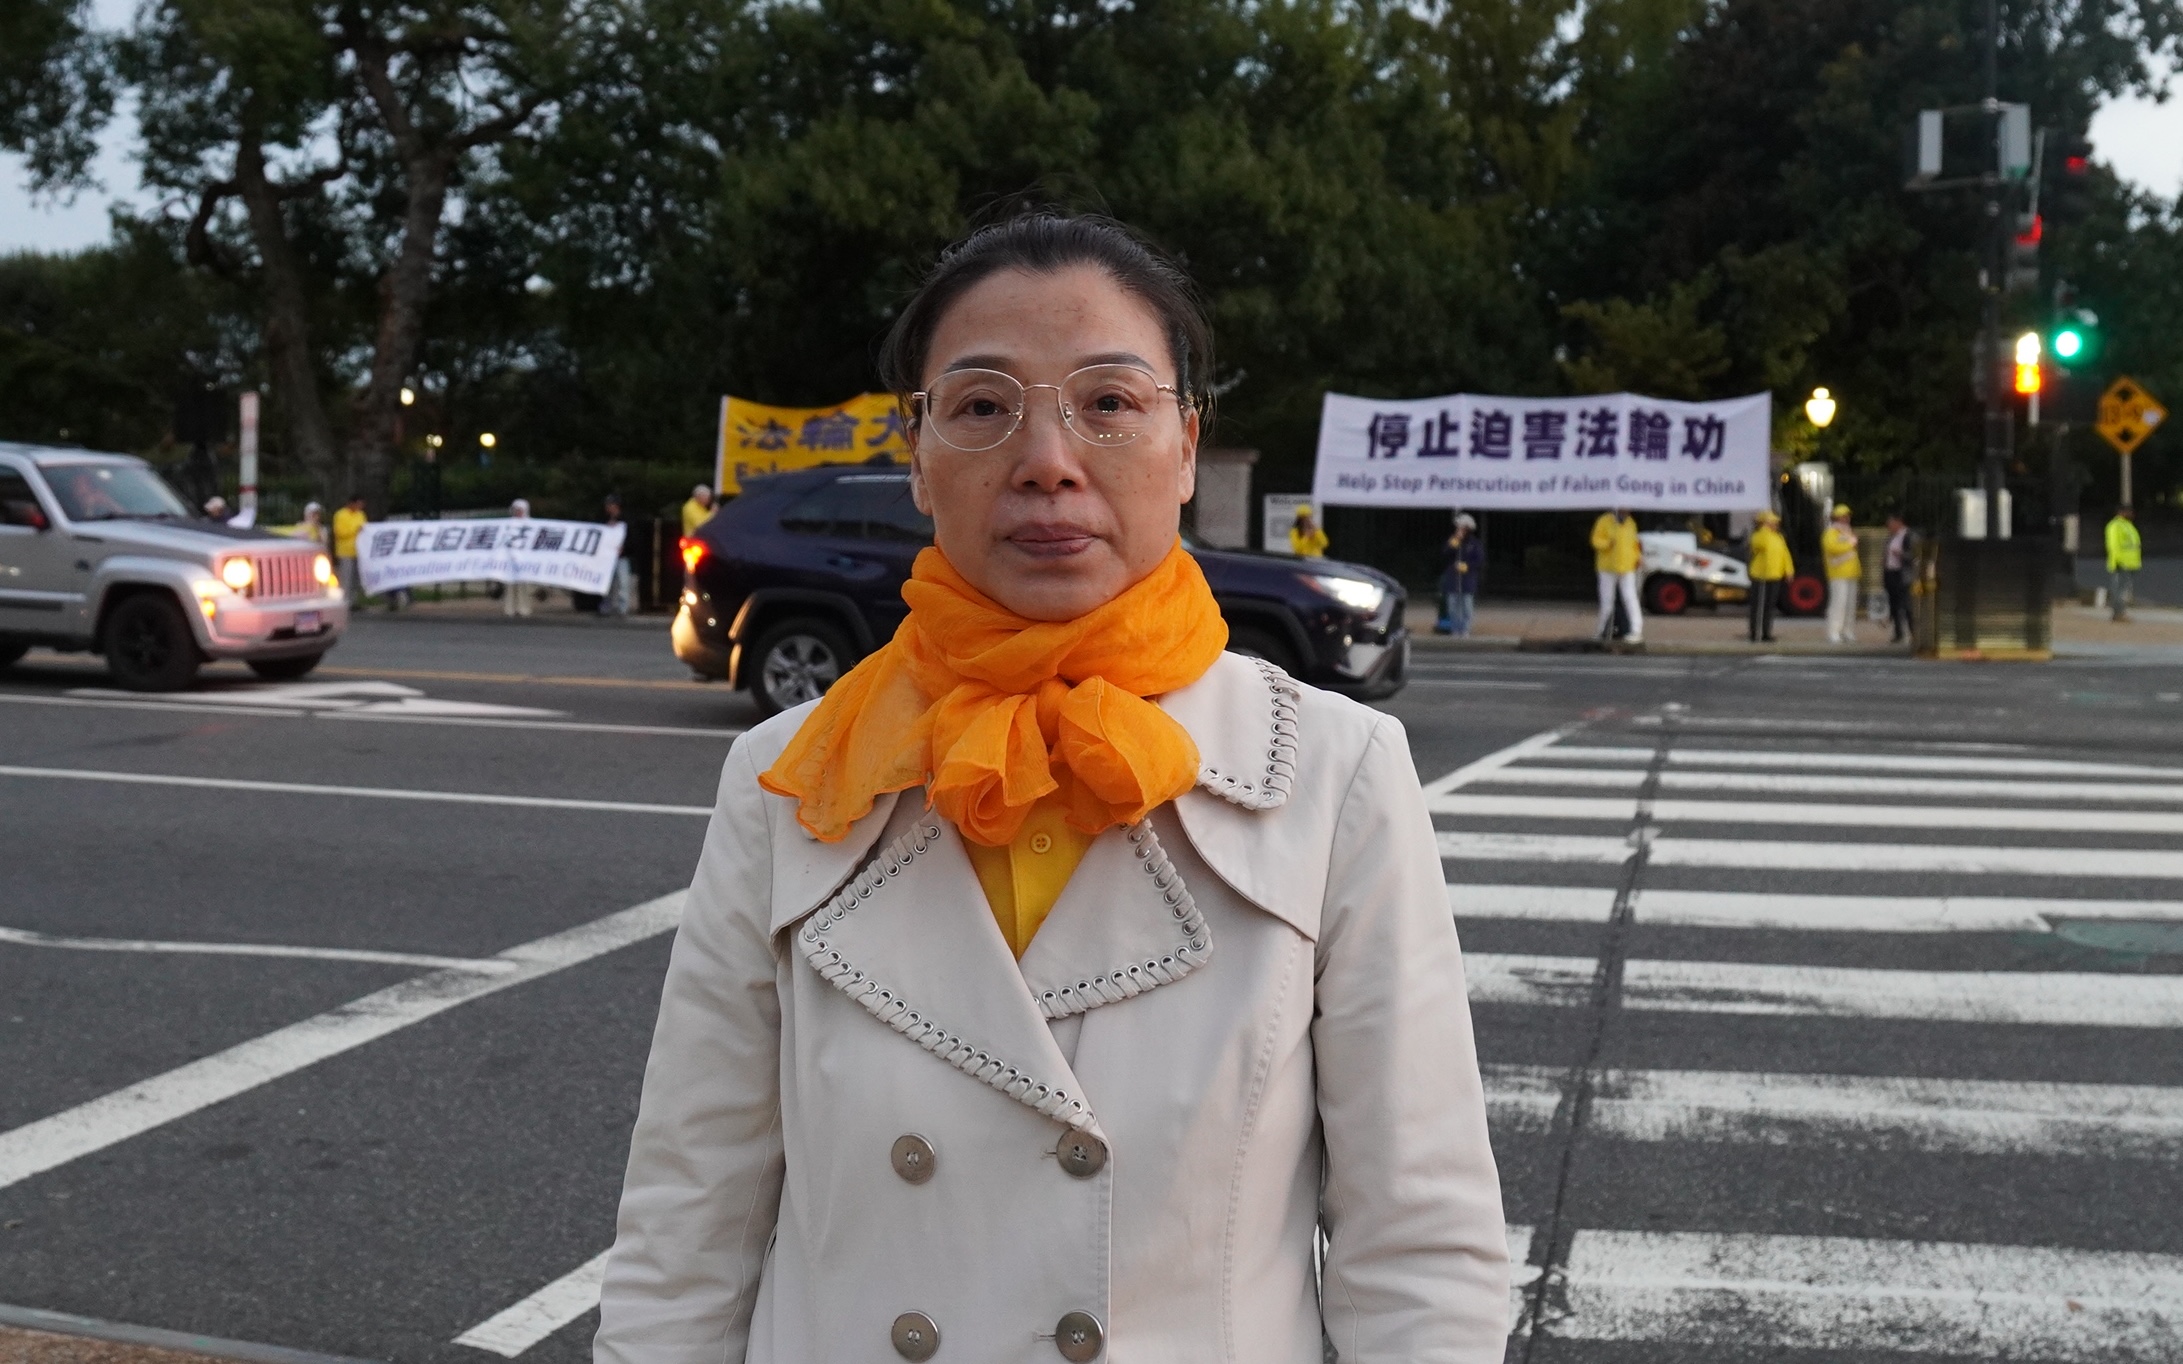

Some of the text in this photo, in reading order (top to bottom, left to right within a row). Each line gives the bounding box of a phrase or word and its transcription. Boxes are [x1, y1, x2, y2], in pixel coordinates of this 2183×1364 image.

[1367, 408, 1726, 461] 停止迫害法輪功
[1337, 472, 1745, 498] Help Stop Persecution of Falun Gong in China
